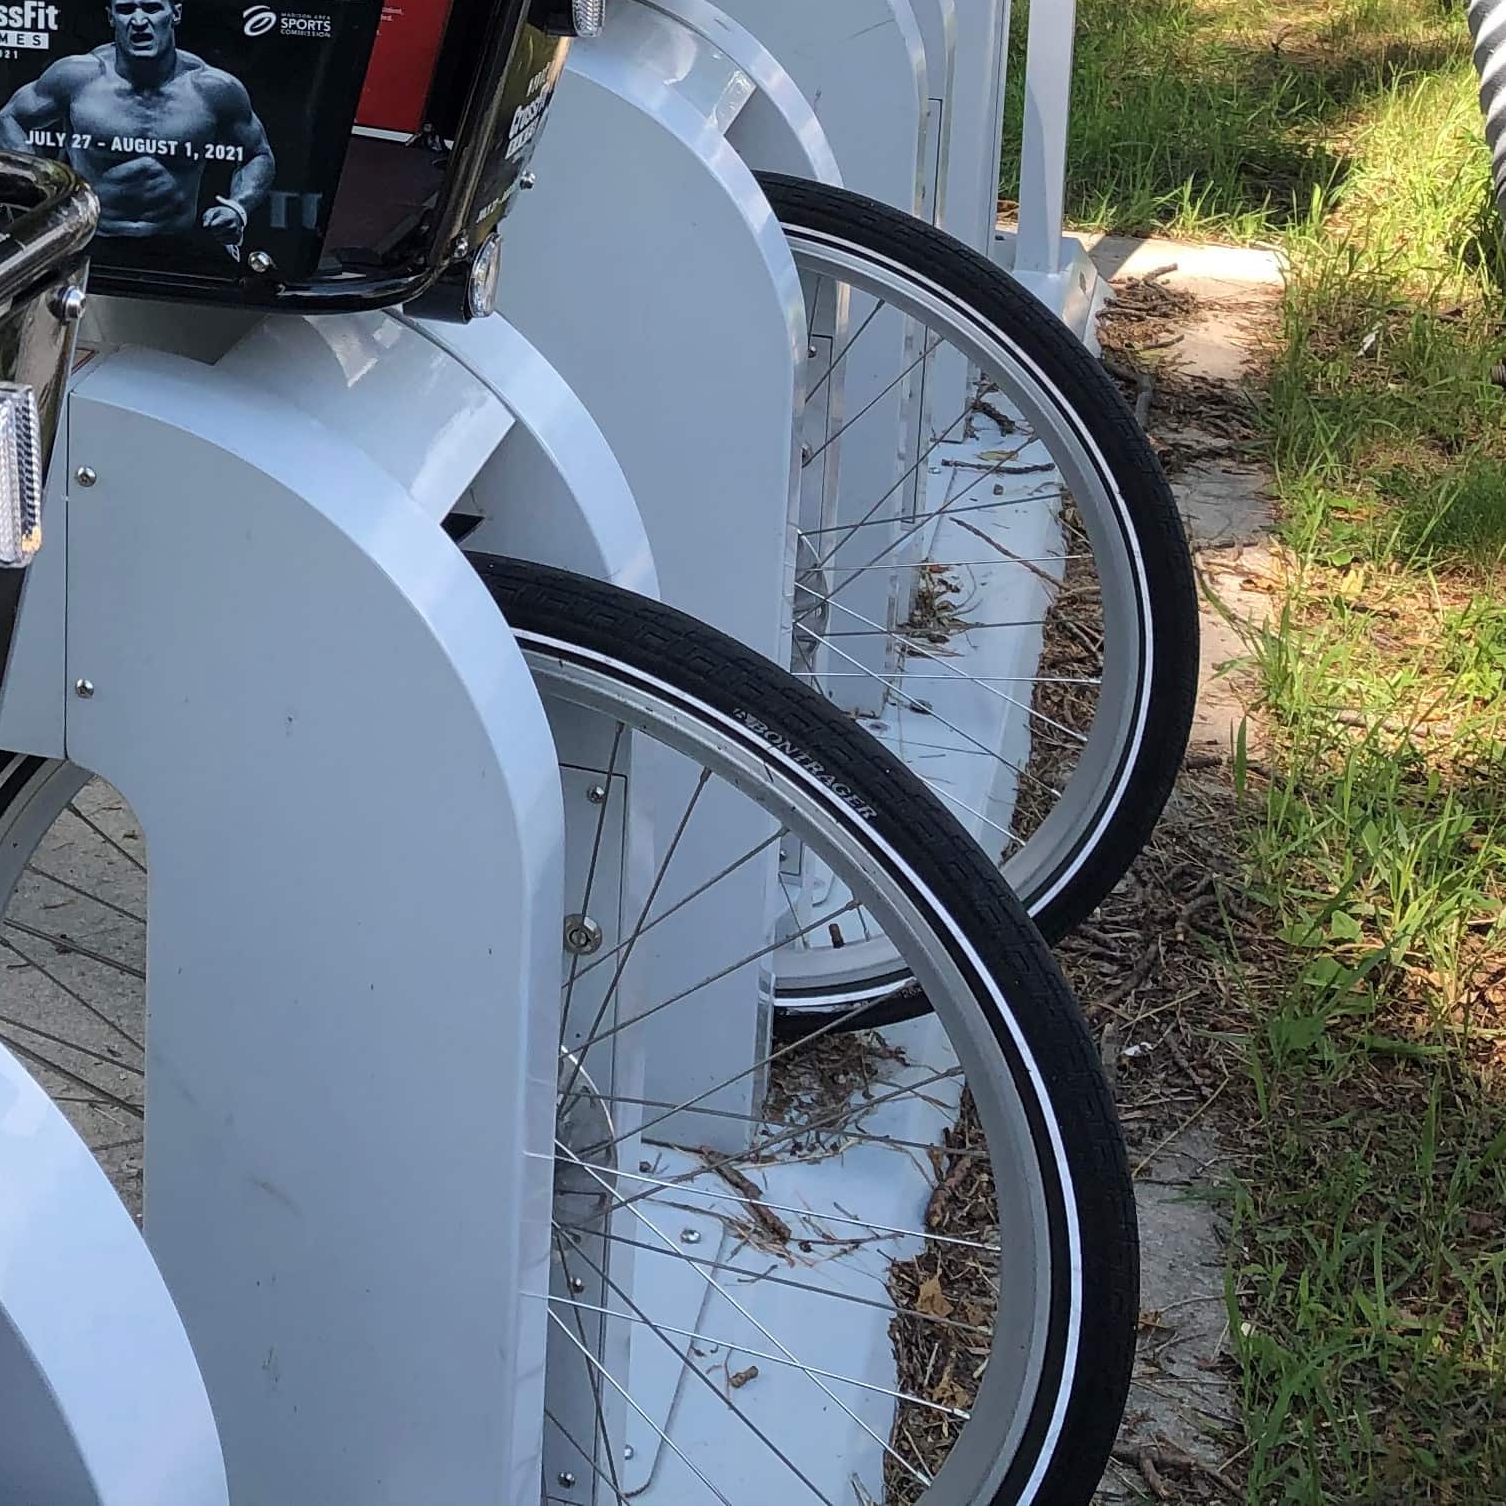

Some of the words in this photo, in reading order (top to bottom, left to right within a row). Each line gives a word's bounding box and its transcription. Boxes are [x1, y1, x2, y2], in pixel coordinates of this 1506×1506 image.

[280, 18, 331, 31] SPORTS
[25, 130, 66, 147] JULY
[71, 134, 92, 149] 27
[111, 136, 178, 156] AUGUST
[184, 142, 199, 161] 1,
[204, 144, 243, 161] 2021
[750, 717, 879, 821] BONTRAGER
